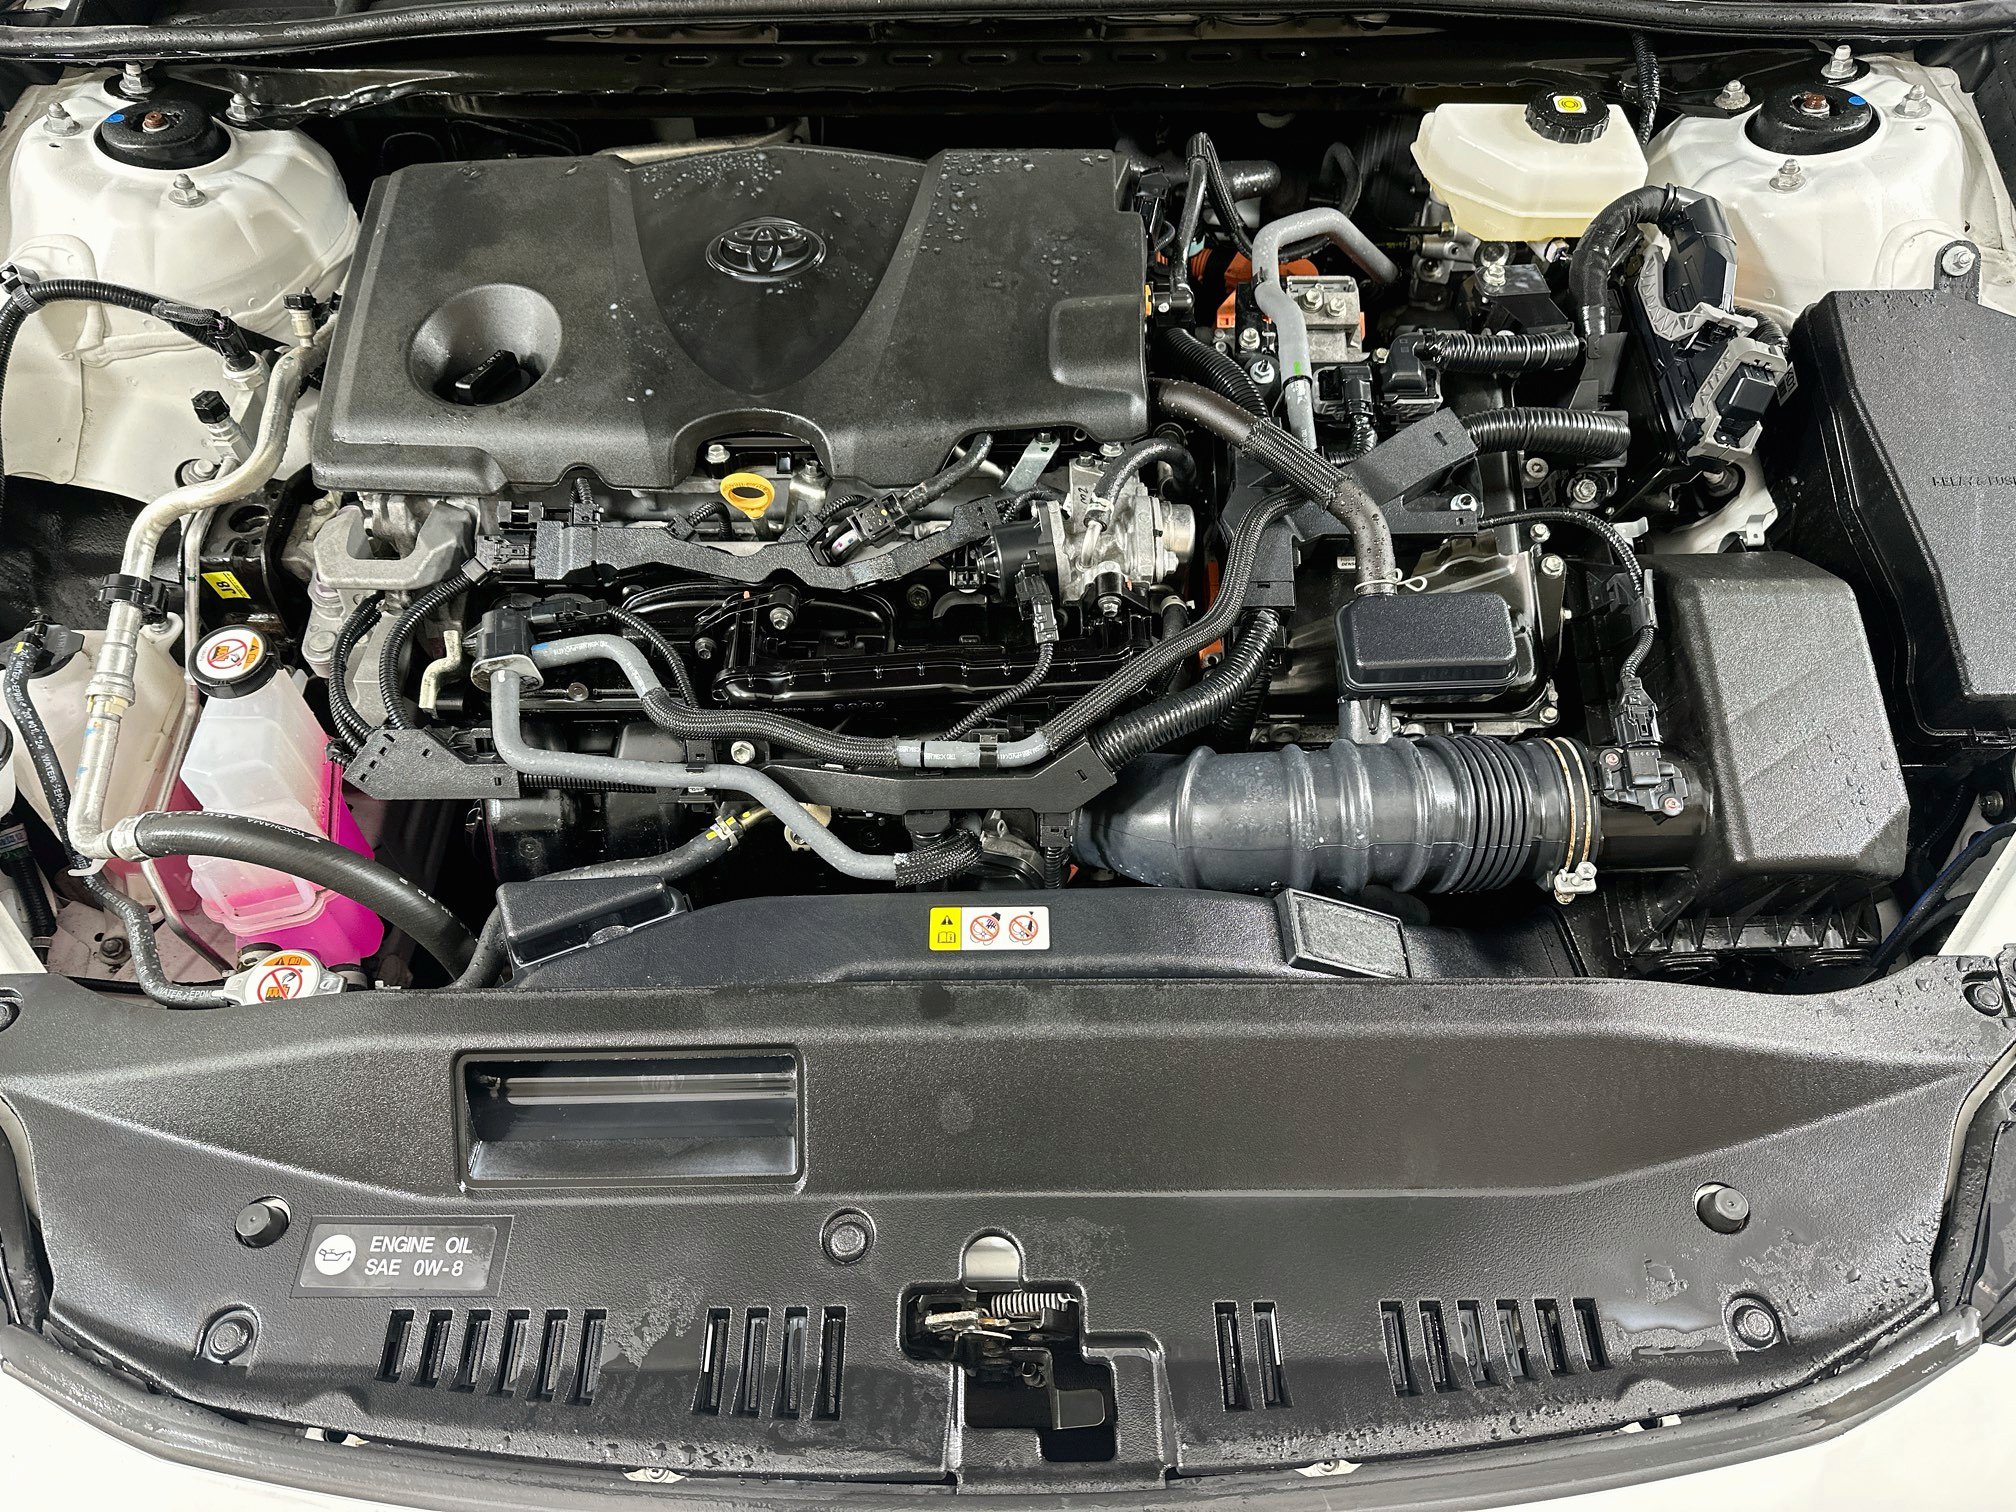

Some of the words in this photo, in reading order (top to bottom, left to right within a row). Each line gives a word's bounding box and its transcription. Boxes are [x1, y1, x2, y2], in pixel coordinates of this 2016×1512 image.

[216, 581, 236, 594] J8
[247, 818, 305, 837] YOKOHAMA
[156, 985, 183, 1000] WATER
[369, 1235, 435, 1253] ENGINE
[445, 1236, 473, 1254] OIL
[364, 1258, 402, 1276] SAE
[413, 1259, 464, 1277] 0W-8
